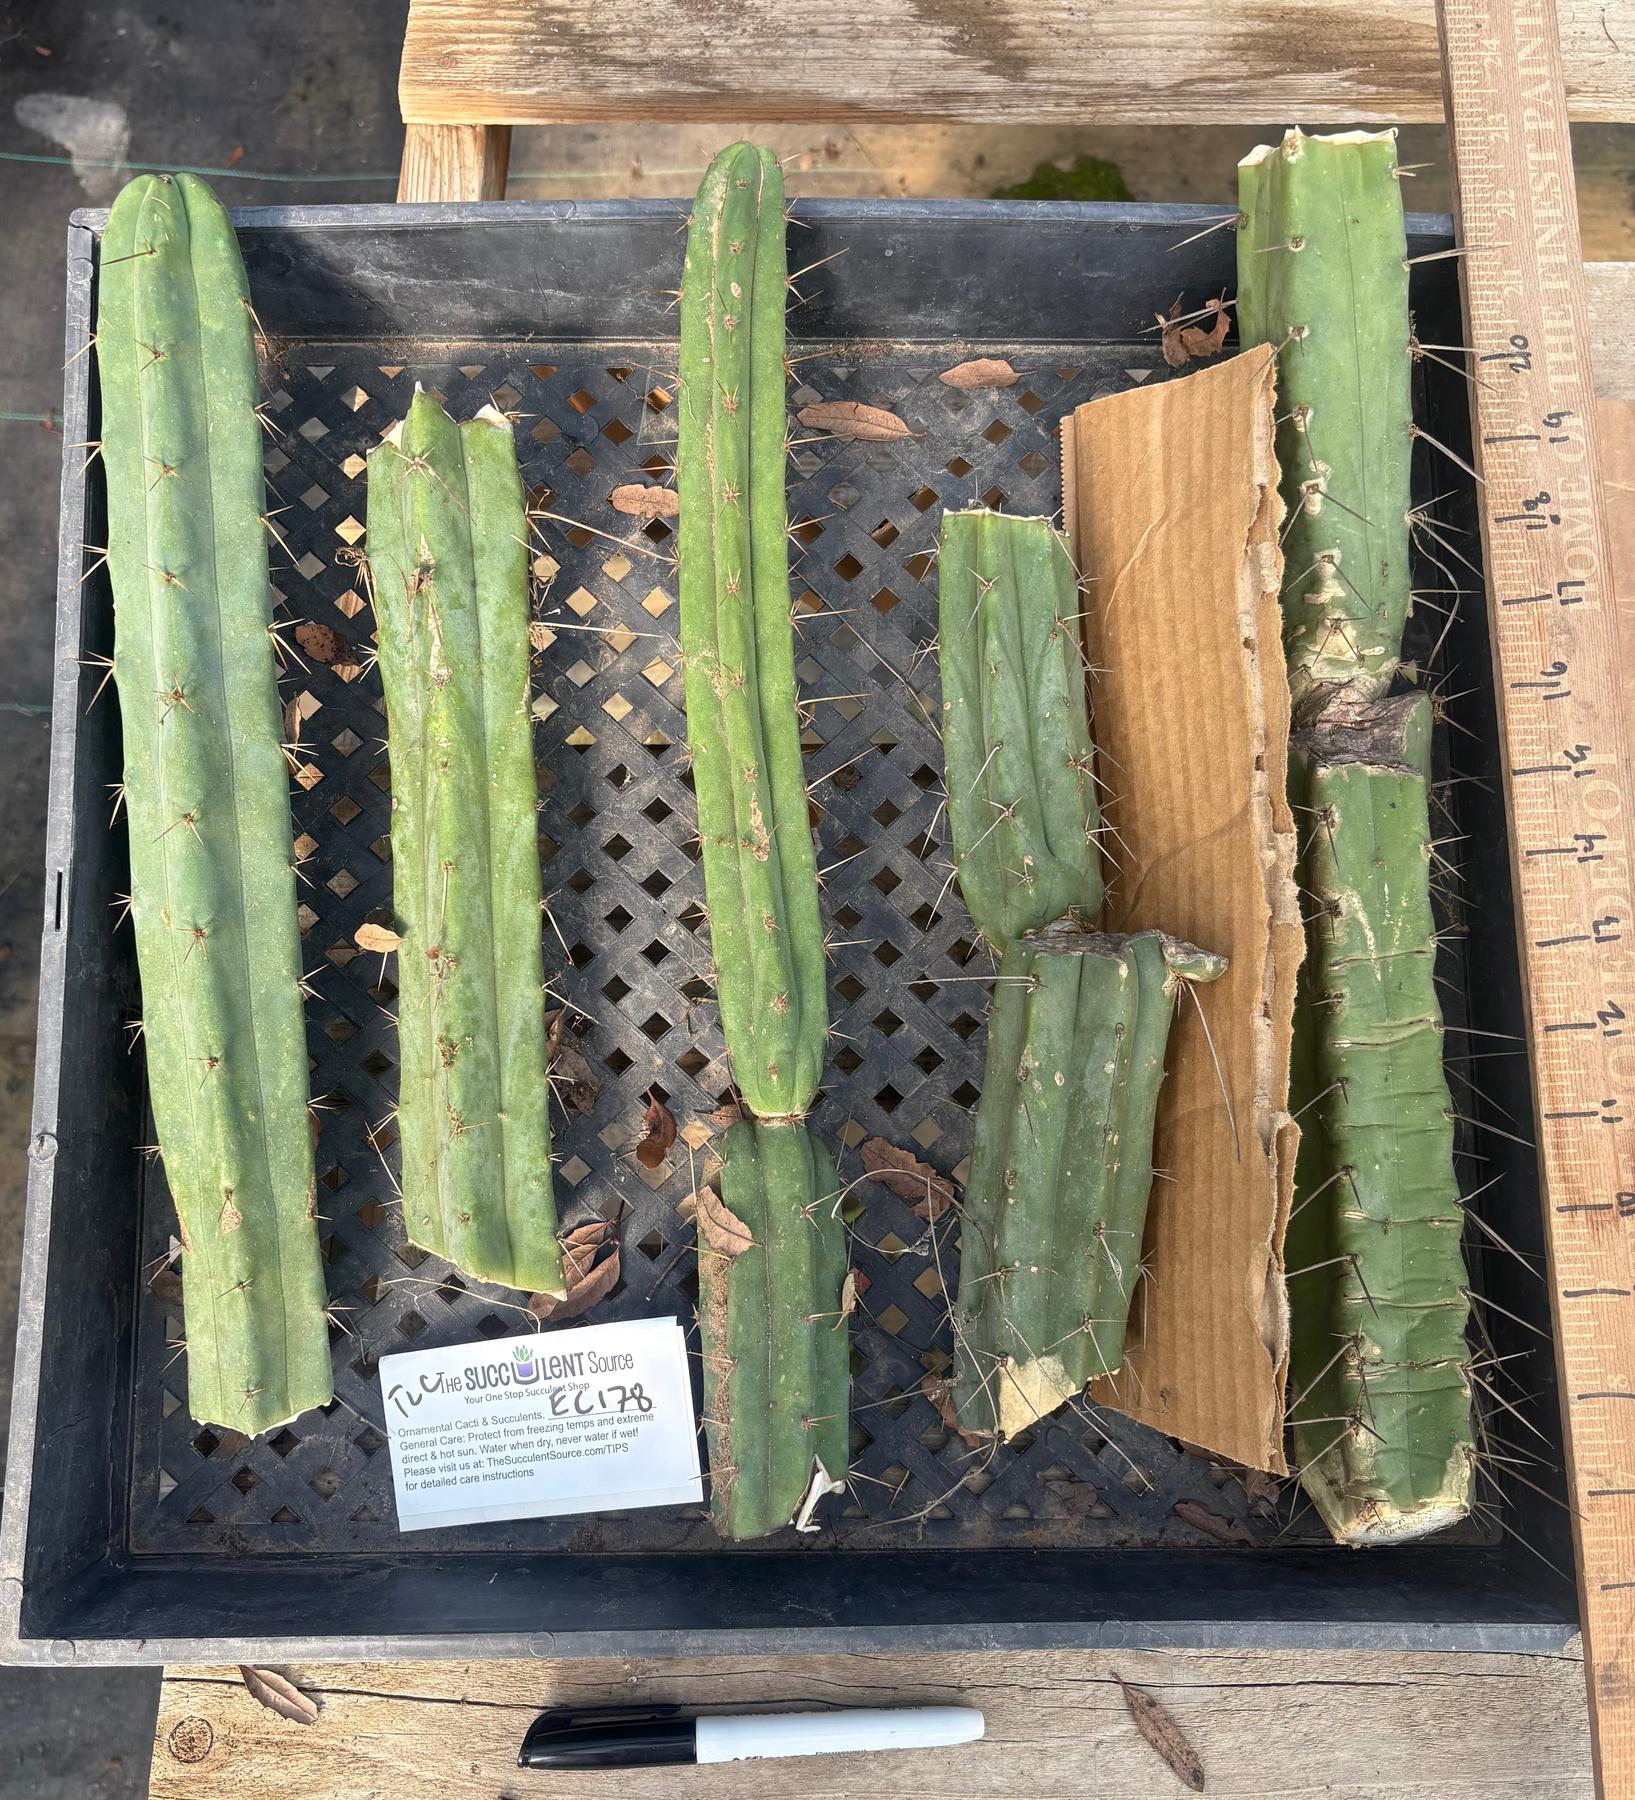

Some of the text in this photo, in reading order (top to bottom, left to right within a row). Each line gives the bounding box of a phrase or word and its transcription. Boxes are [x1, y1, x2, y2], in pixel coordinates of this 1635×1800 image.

[1525, 143, 1569, 292] FINEST
[1509, 334, 1532, 374] 20
[1542, 304, 1580, 393] THE
[1542, 411, 1574, 443] 19
[1557, 581, 1586, 606] 17
[1540, 661, 1571, 700] 16
[1574, 834, 1608, 864] 14
[1596, 1000, 1626, 1039] 12
[588, 1350, 634, 1374] Source
[388, 1374, 442, 1418] TLC
[464, 1381, 590, 1405] Your One Stop Succulent Shop
[549, 1382, 653, 1416] EC178
[398, 1411, 546, 1438] Ornamental Cacti & Succulents.
[400, 1412, 654, 1451] General Care: Protect from freezing temps and extreme
[401, 1427, 639, 1465] direct & hot sun. Water when dry, never water if wet!
[403, 1443, 629, 1478] Please visit us at: TheSucculentSource.com/TIPS
[405, 1468, 535, 1491] for detailed care instructions
